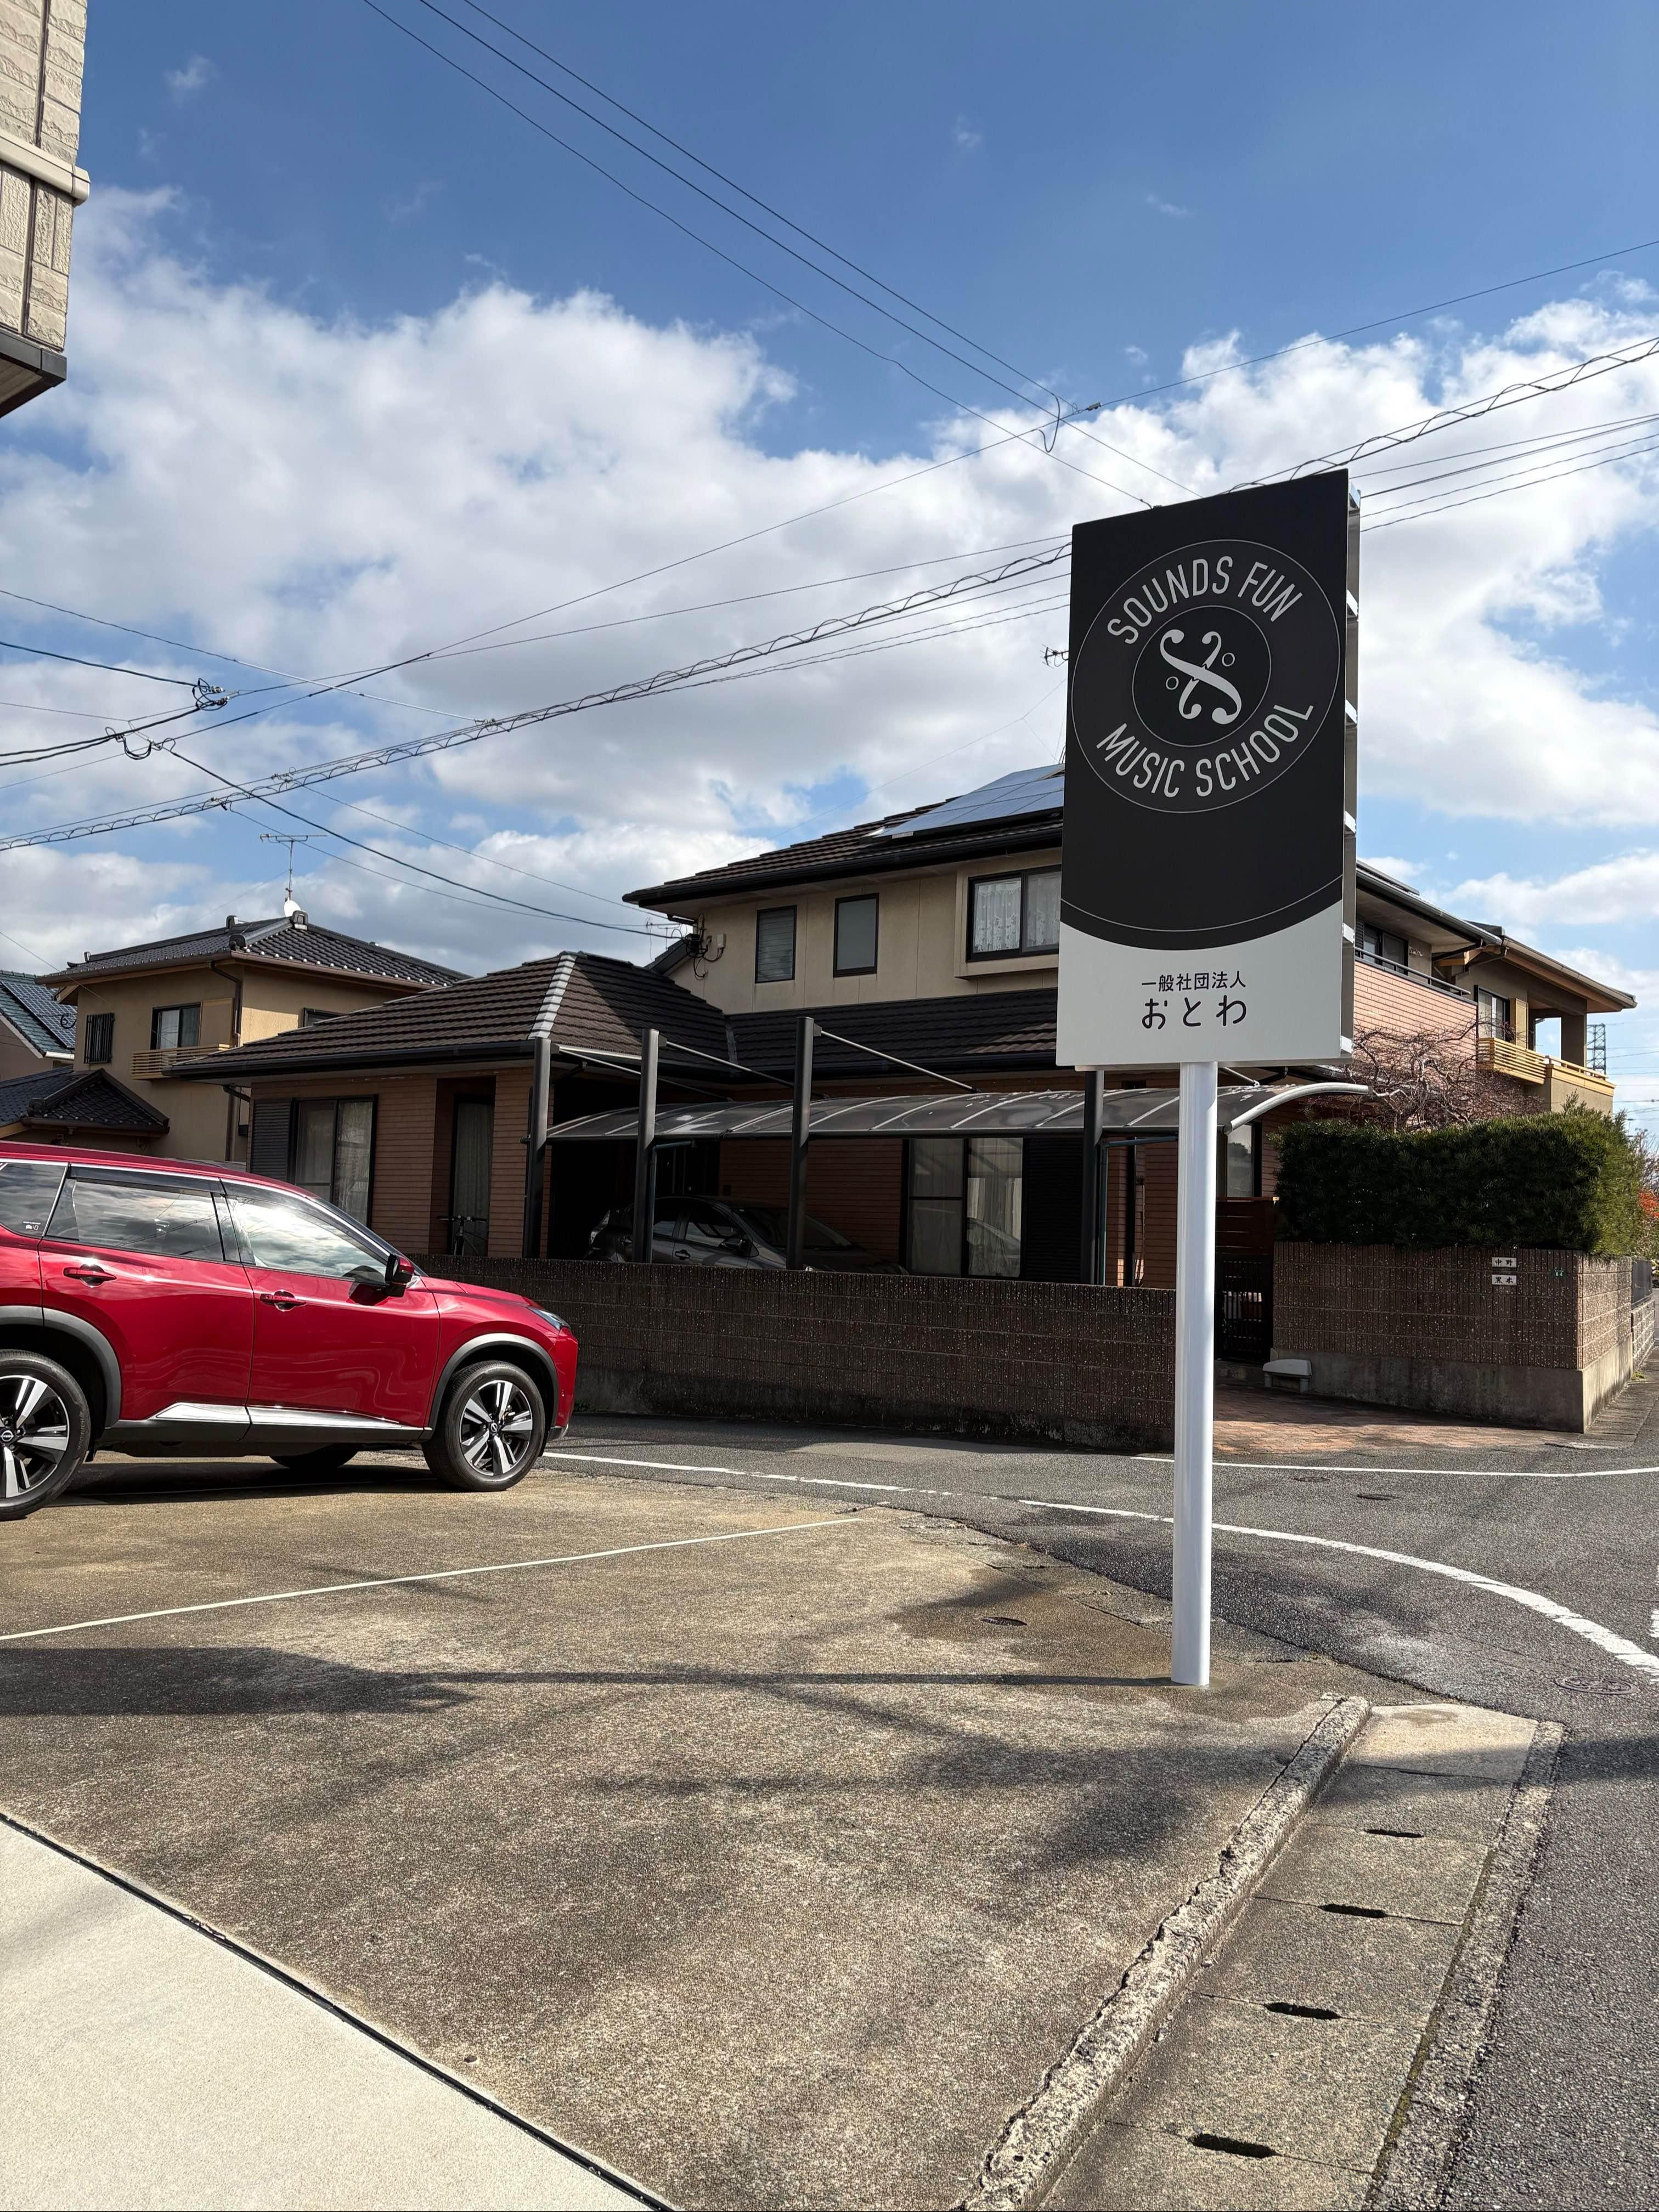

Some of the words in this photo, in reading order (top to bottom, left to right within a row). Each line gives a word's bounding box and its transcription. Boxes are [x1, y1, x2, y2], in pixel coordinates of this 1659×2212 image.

[1107, 556, 1233, 644] SOUNDS
[1237, 561, 1303, 622] FUN
[1096, 723, 1185, 797] MUSIC
[1195, 704, 1314, 796] SCHOOL
[1141, 970, 1246, 992] 一般社団法人
[1142, 994, 1246, 1029] おとわ
